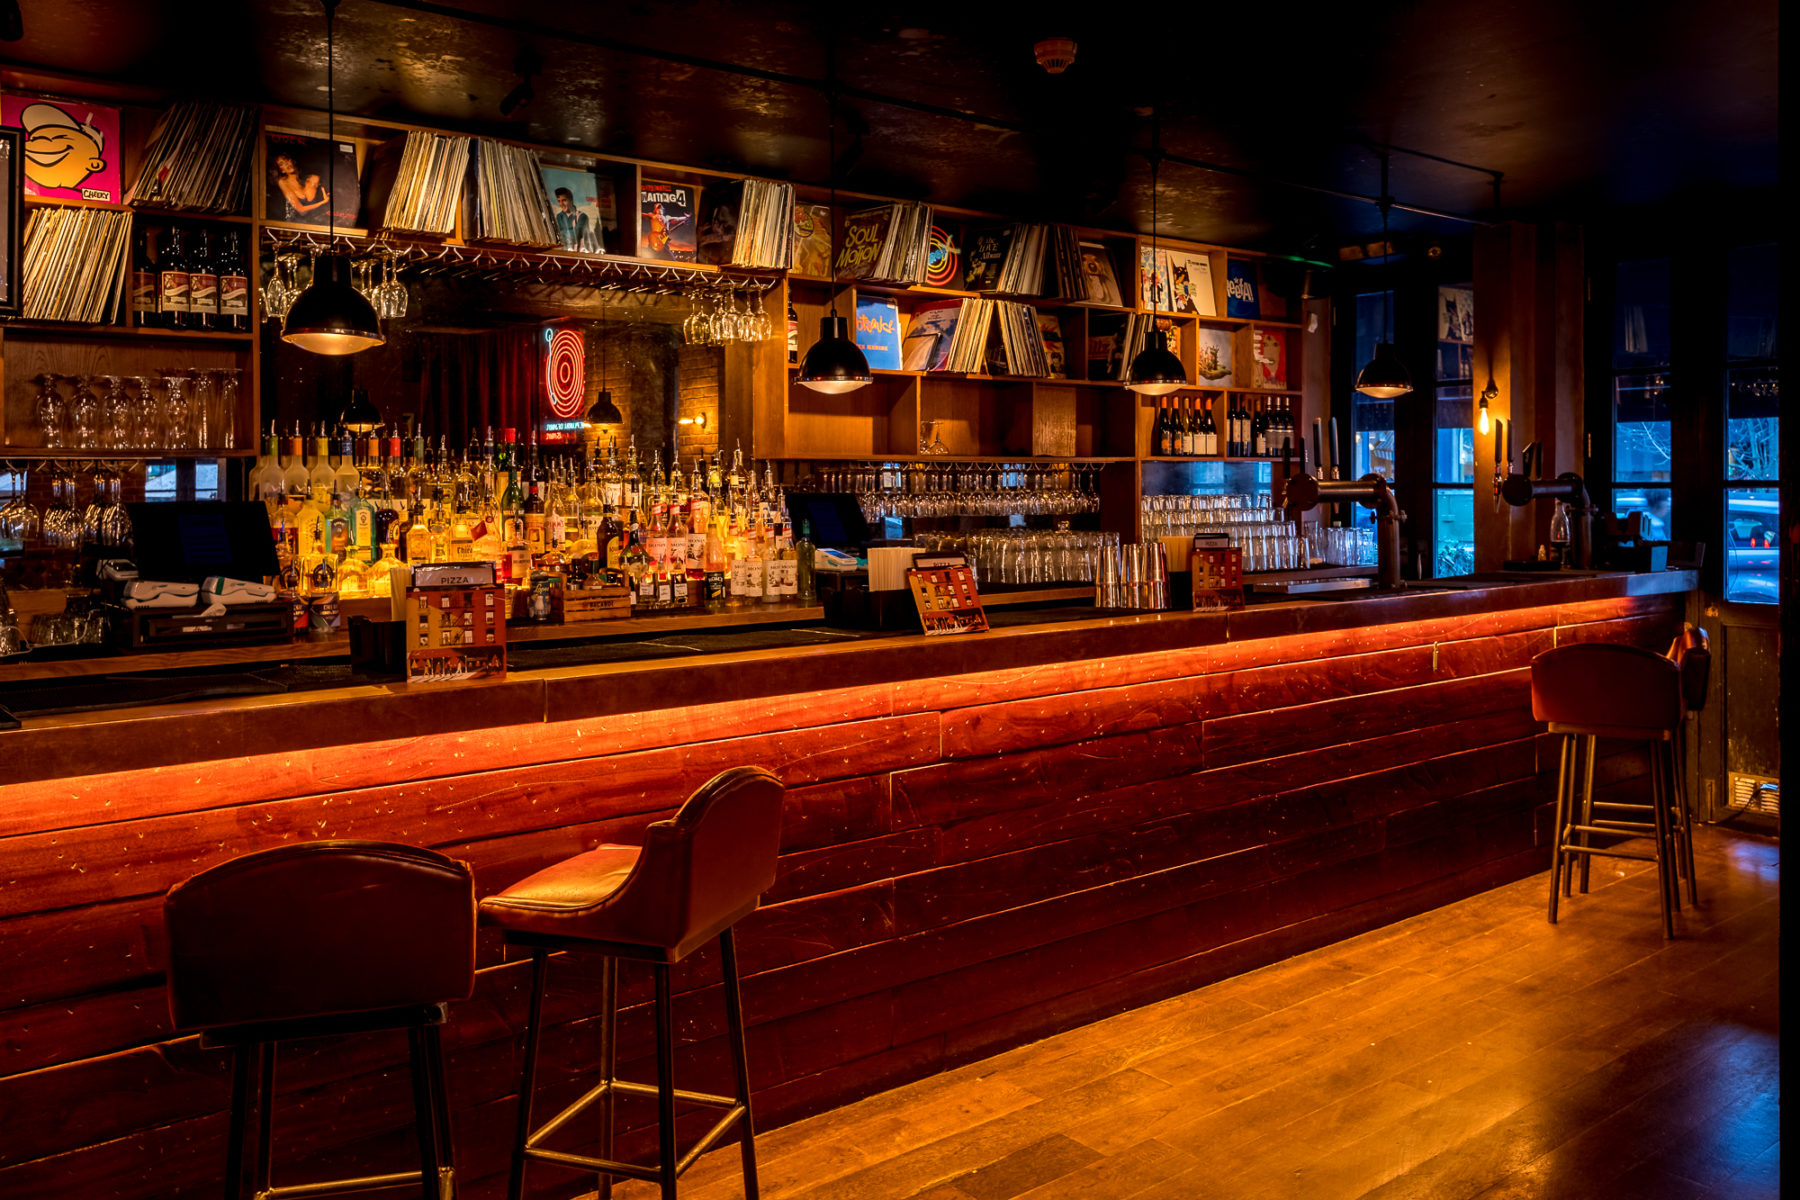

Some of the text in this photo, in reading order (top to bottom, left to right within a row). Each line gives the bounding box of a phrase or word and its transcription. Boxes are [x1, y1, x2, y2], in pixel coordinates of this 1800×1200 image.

[845, 223, 879, 248] SOUL
[835, 240, 883, 268] MOTION
[440, 576, 469, 584] PIZZA
